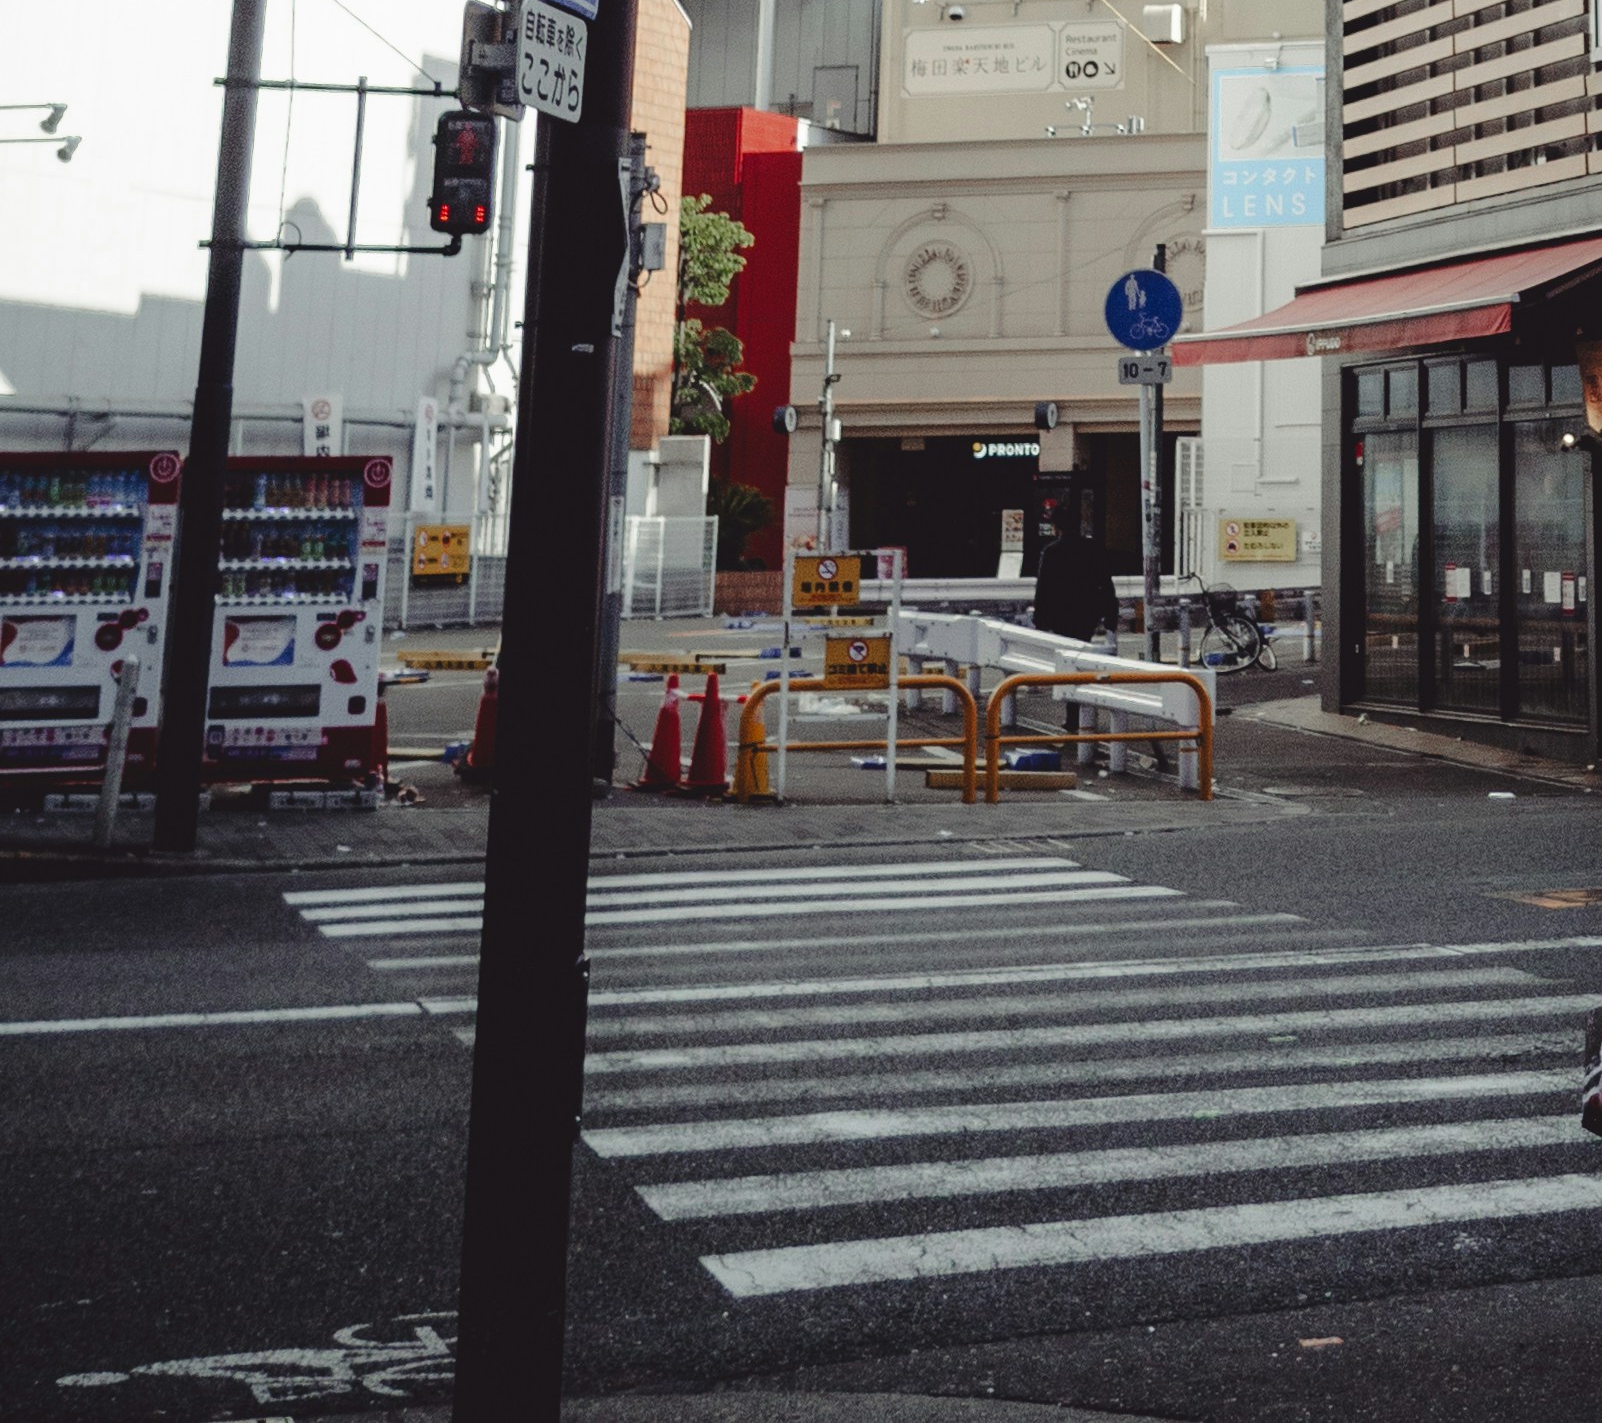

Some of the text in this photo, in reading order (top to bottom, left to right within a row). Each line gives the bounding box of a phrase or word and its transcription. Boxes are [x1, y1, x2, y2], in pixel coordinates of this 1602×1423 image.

[525, 9, 583, 61] 自転車を除く
[1066, 34, 1117, 44] Restaurant
[1066, 47, 1098, 57] Cinema
[911, 56, 1047, 78] 梅田楽天地ビル
[521, 52, 580, 112] ここから
[1223, 166, 1317, 186] コンタクト
[1223, 191, 1306, 218] LENS
[988, 441, 1040, 457] PRONTO
